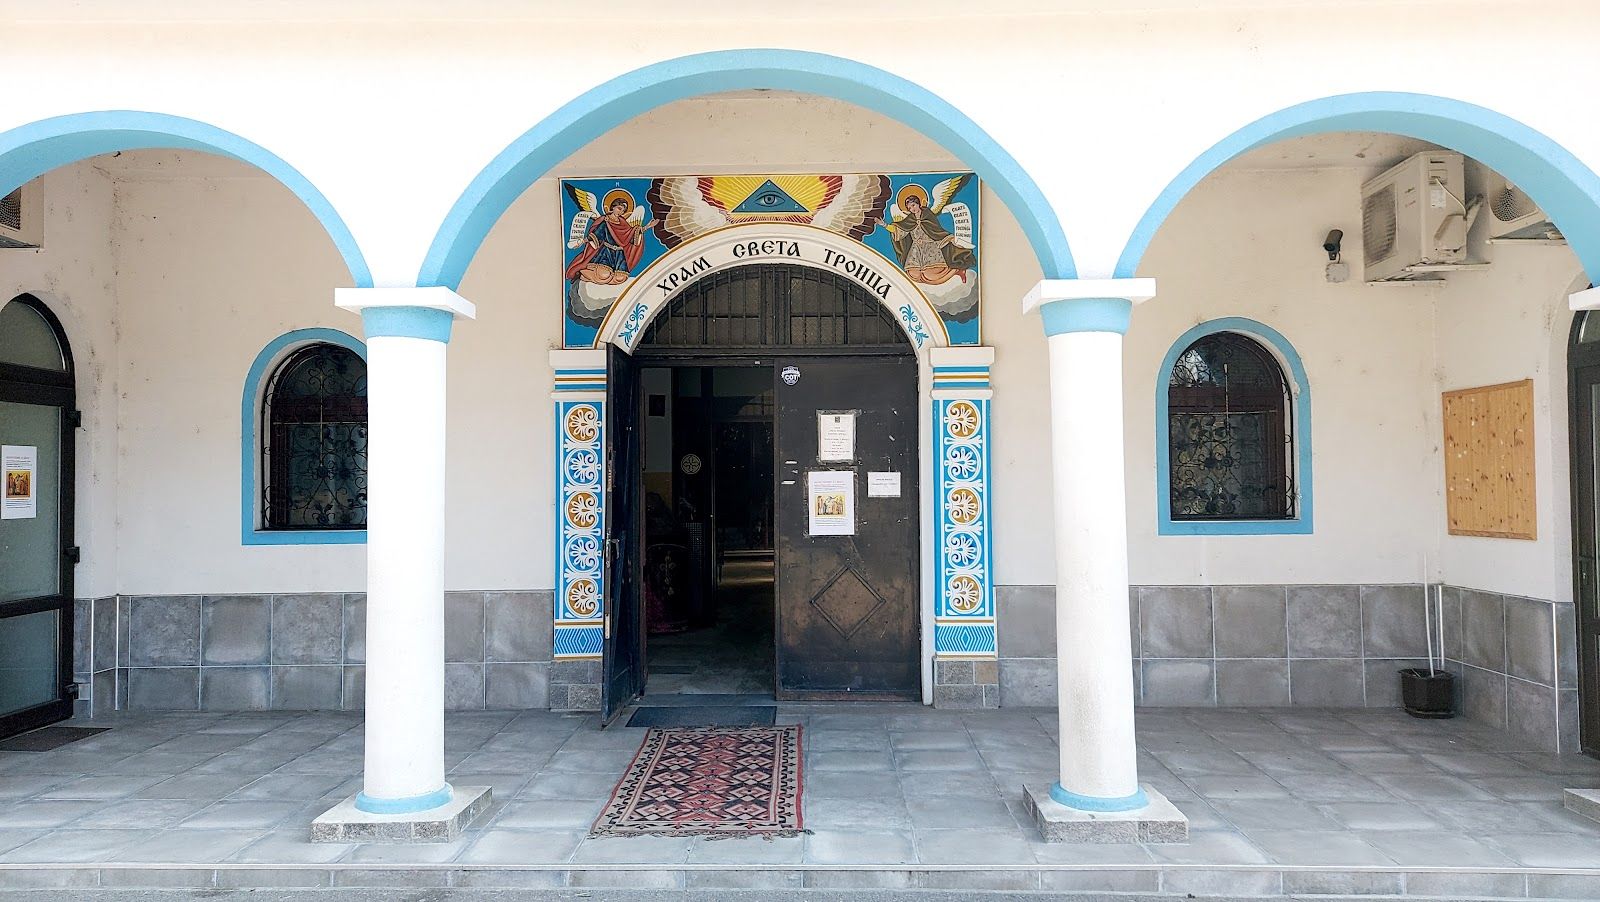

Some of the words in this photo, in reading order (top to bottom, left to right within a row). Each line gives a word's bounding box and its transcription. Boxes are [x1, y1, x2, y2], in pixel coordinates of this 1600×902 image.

[656, 256, 713, 297] ХРАМ
[732, 240, 802, 258] СВЕТА
[824, 249, 892, 299] ТРОИЦА
